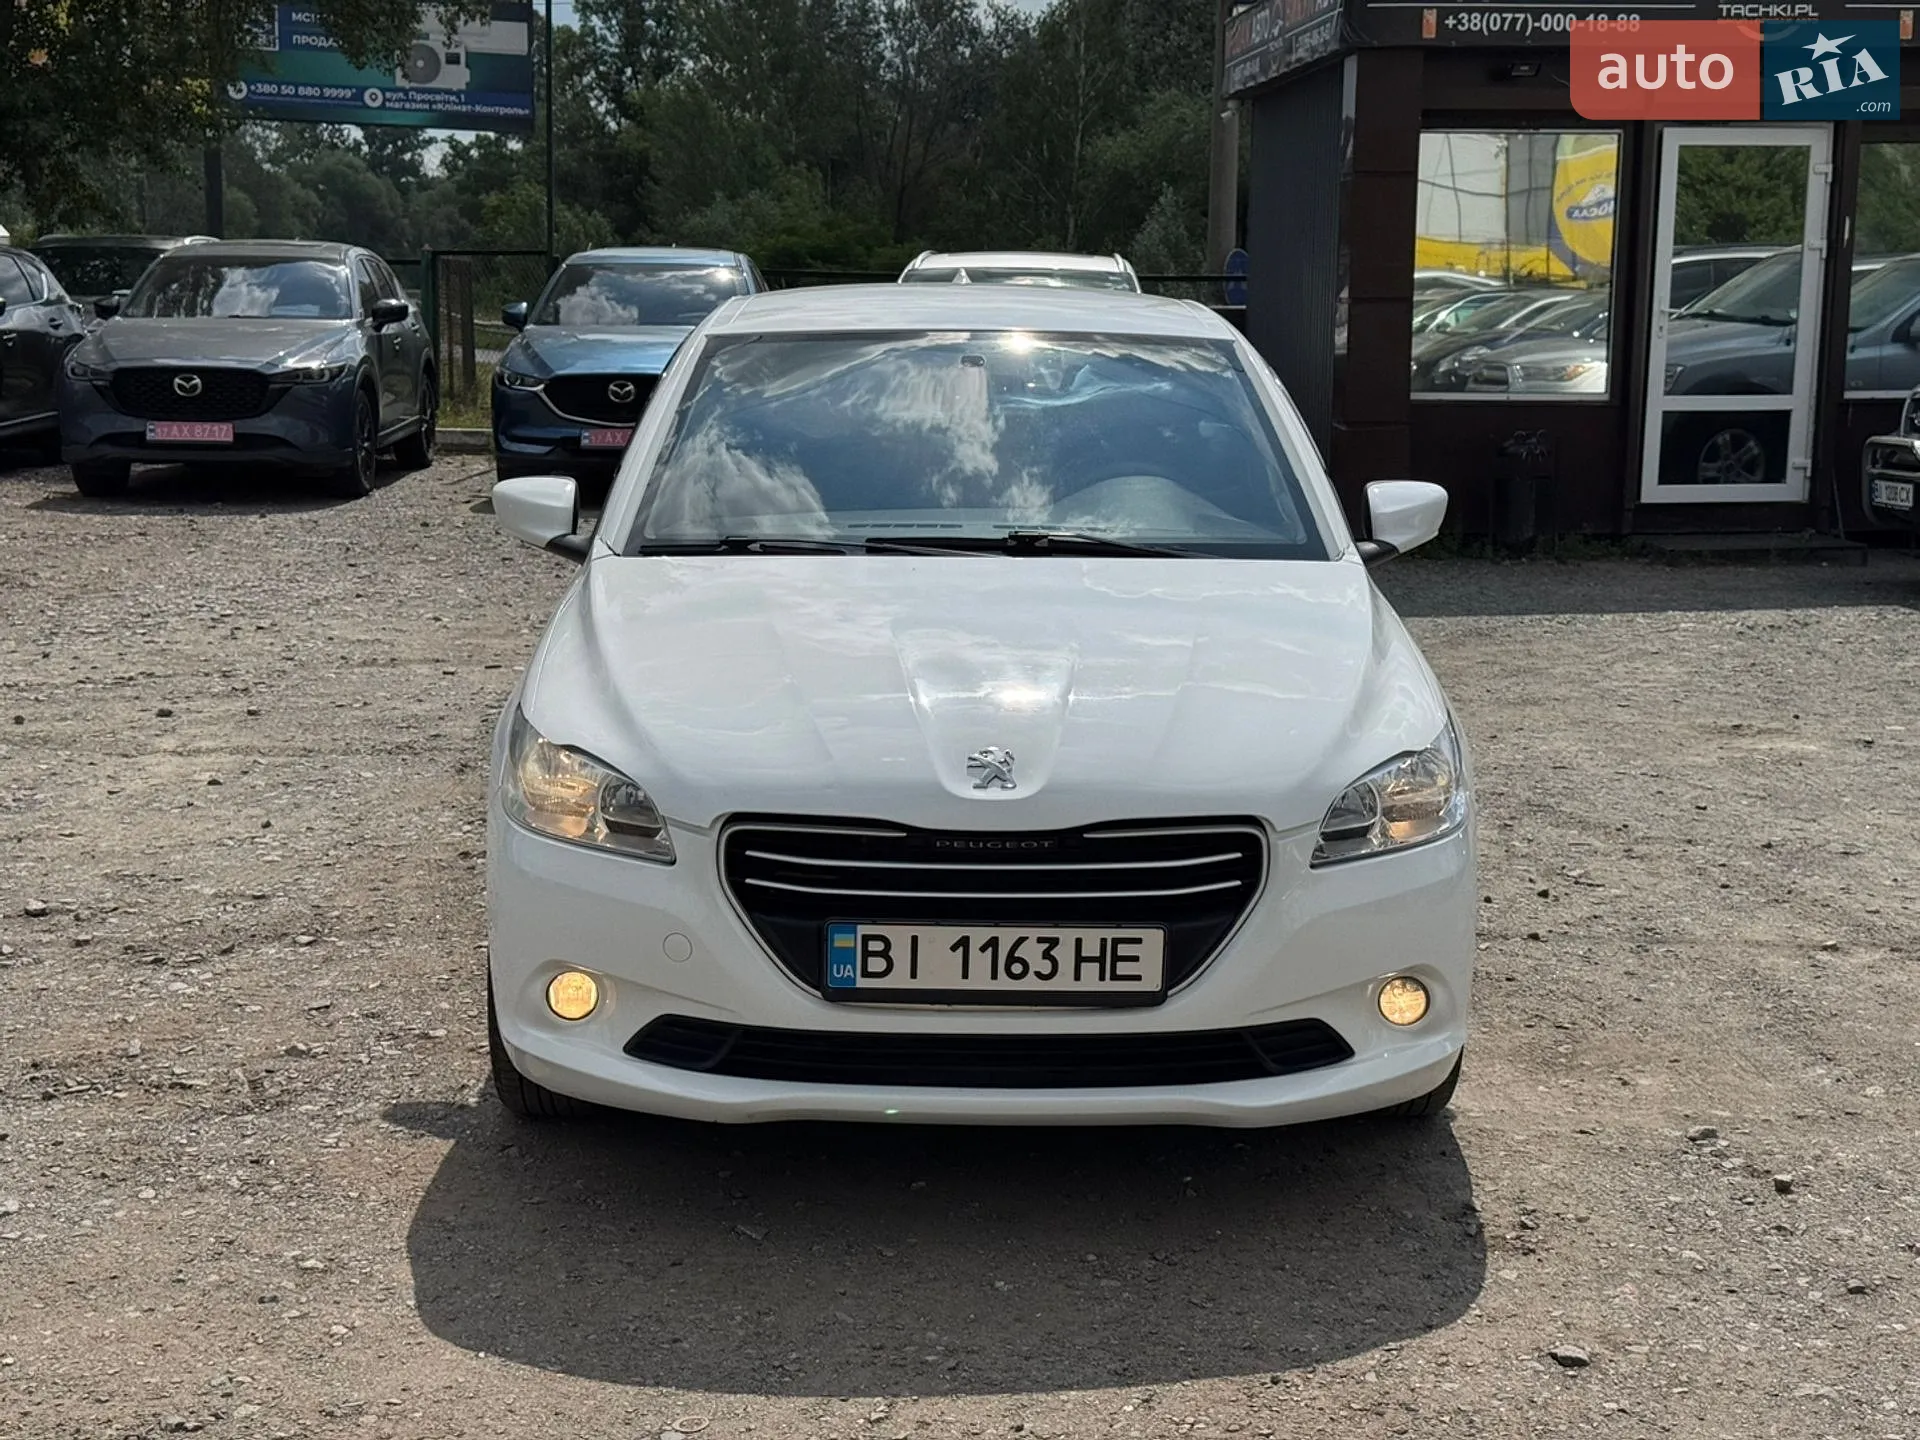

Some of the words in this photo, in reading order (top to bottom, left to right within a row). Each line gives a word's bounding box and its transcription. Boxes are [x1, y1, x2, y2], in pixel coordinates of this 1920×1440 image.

[1718, 4, 1818, 17] TACHKI.PL
[1444, 12, 1640, 36] +38(077)-000-18-88
[250, 83, 278, 94] +380
[280, 84, 296, 95] 50
[298, 86, 321, 97] 880
[385, 101, 430, 110] магазин
[935, 839, 1054, 849] PEUGEOT
[833, 963, 854, 978] UA
[860, 933, 919, 980] BI
[949, 935, 1060, 981] 1163
[1073, 936, 1142, 982] HE
